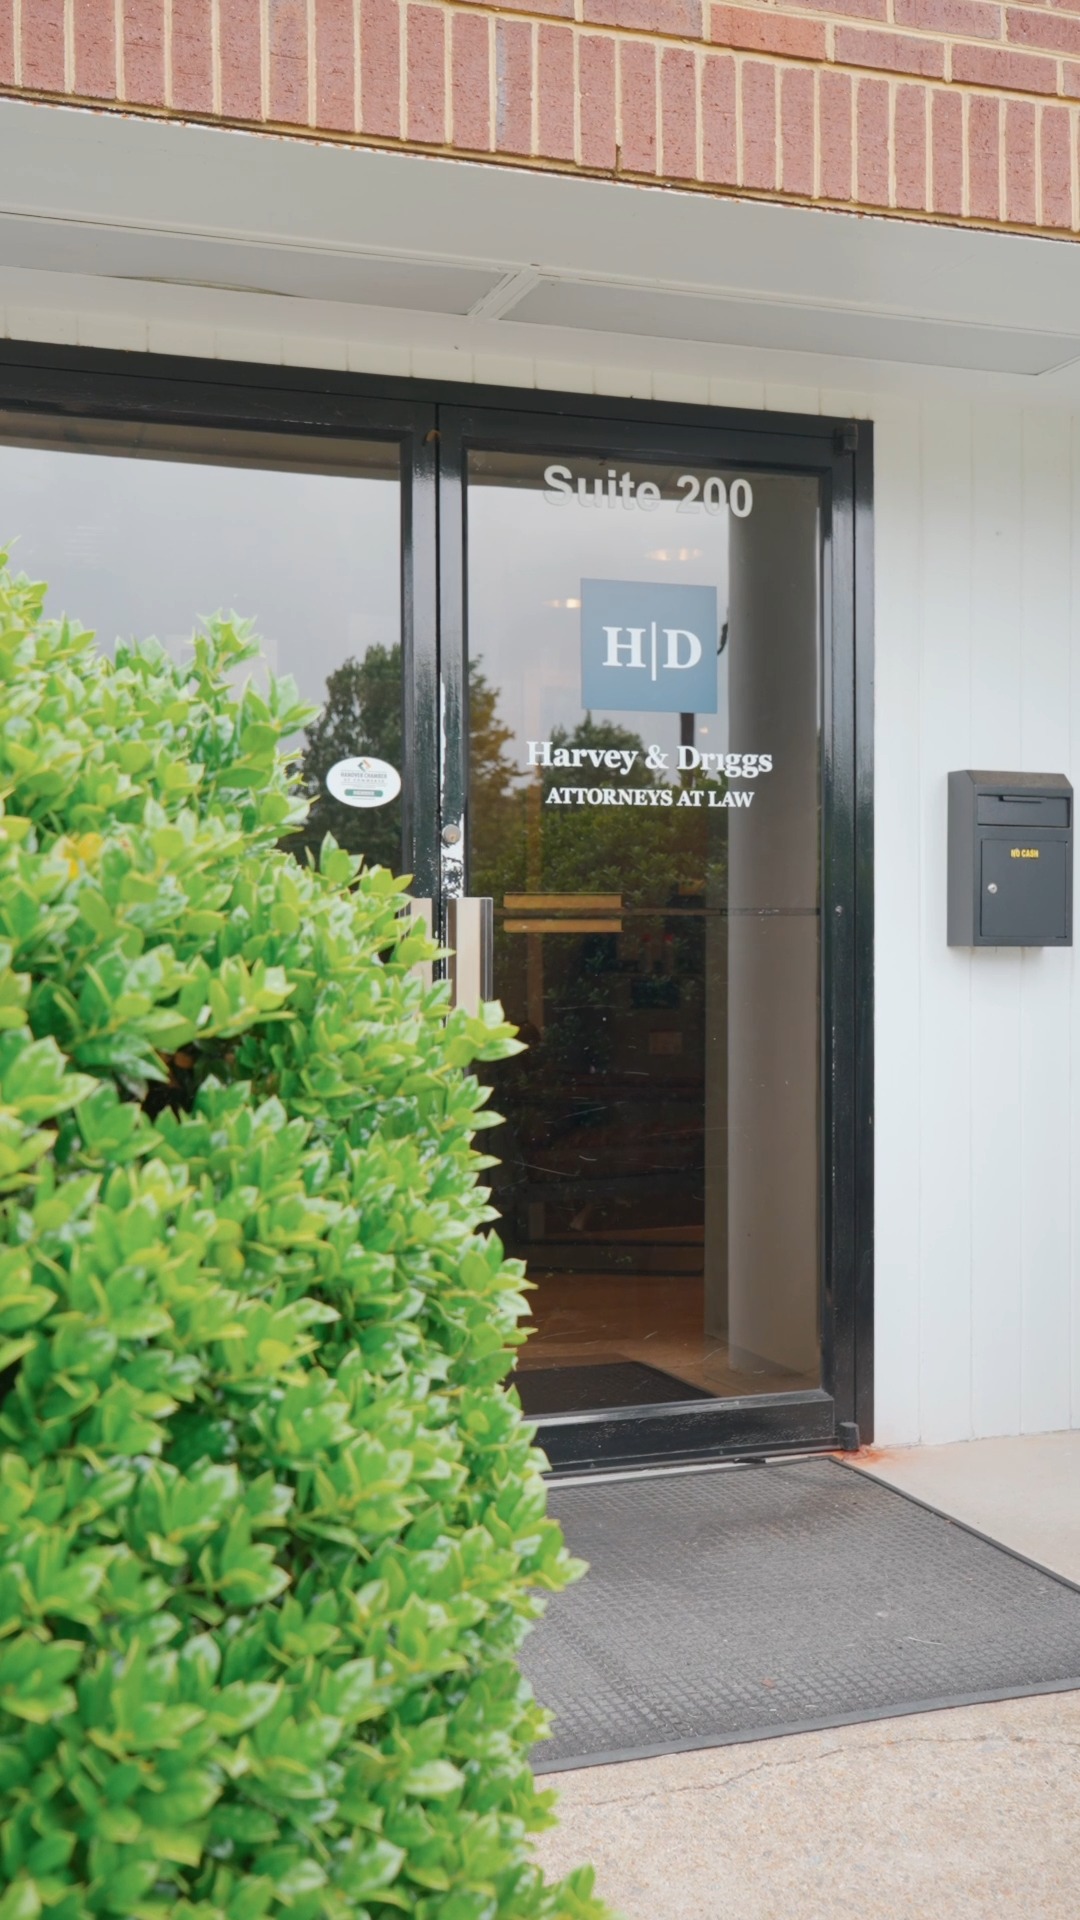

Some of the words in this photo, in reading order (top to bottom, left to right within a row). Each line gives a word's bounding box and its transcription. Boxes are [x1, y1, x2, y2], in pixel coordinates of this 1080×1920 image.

[543, 465, 661, 511] Suite
[676, 475, 753, 518] 200
[526, 742, 638, 775] Harvey
[645, 745, 669, 769] &
[677, 747, 773, 778] Driggs
[545, 787, 673, 806] ATTORNEYS
[676, 788, 704, 807] AT
[708, 790, 755, 808] LAW
[1010, 848, 1020, 858] NO
[1021, 848, 1039, 858] CASH
